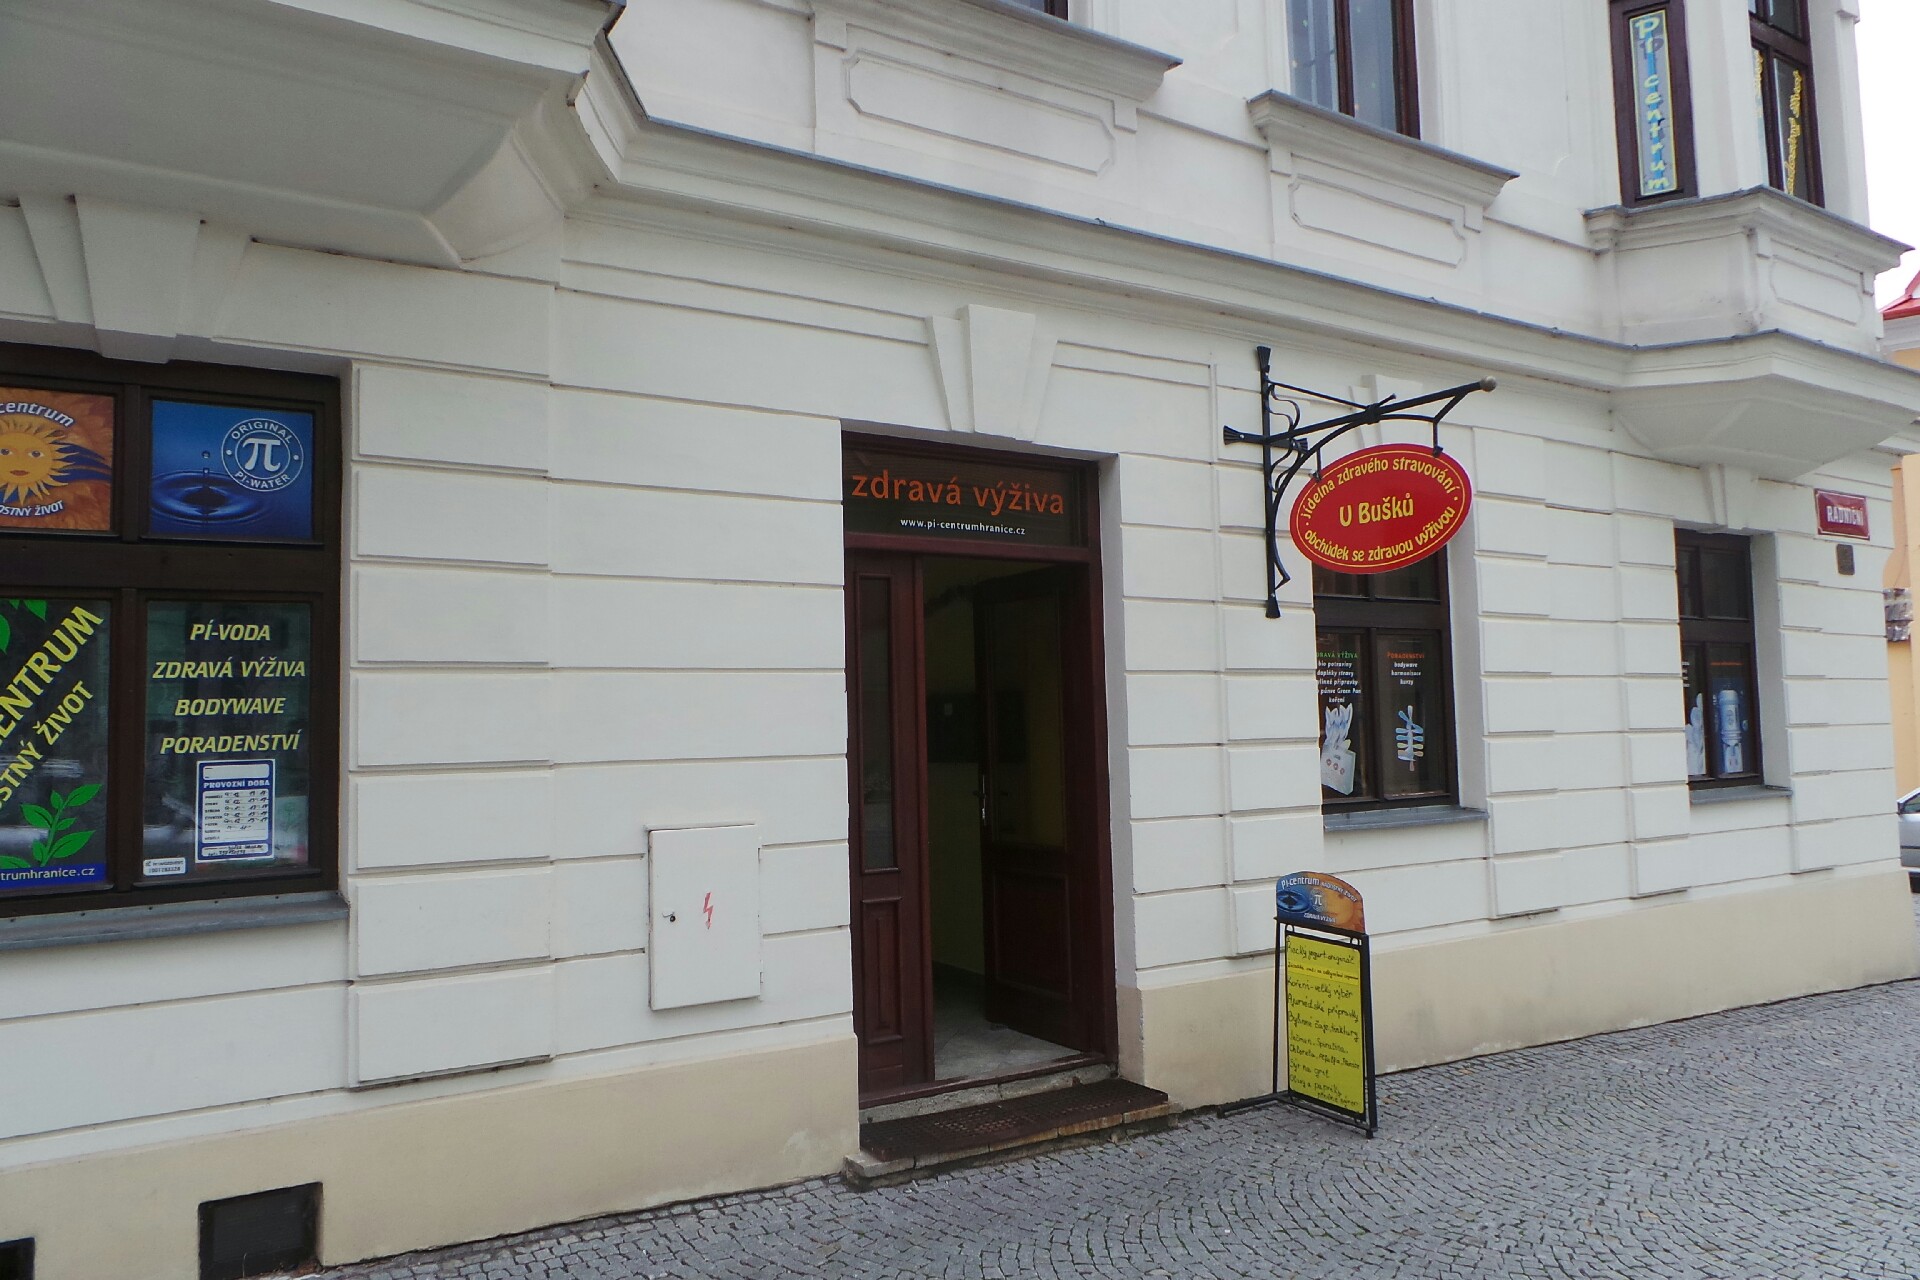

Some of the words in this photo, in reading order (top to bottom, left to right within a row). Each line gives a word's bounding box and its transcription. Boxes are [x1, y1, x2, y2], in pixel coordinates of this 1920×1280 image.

[1643, 73, 1670, 189] centrum
[231, 421, 292, 443] ORIGINAL
[235, 471, 290, 488] PI-WATER
[1301, 479, 1336, 519] jídelna
[1336, 458, 1389, 485] zdravého
[1392, 456, 1461, 494] stravování
[852, 469, 961, 505] zdravá
[973, 481, 1064, 516] výživa
[34, 500, 64, 516] ŽIVOT
[1339, 505, 1352, 527] U
[1358, 492, 1414, 524] Bušků
[900, 518, 1025, 535] www.pi-centrumhranice.cz
[1304, 529, 1349, 561] obchůdek
[1351, 549, 1365, 562] se
[1367, 539, 1414, 562] zdravou
[1414, 505, 1456, 546] výživou
[190, 619, 271, 641] PÍ-VODA
[152, 656, 233, 679] ZDRAVÁ
[241, 656, 306, 677] VÝŽIVA
[1318, 659, 1327, 667] bio
[32, 680, 94, 746] ŽIVOT
[174, 697, 287, 716] BODYWAVE
[159, 728, 303, 755] PORADENSTVÍ
